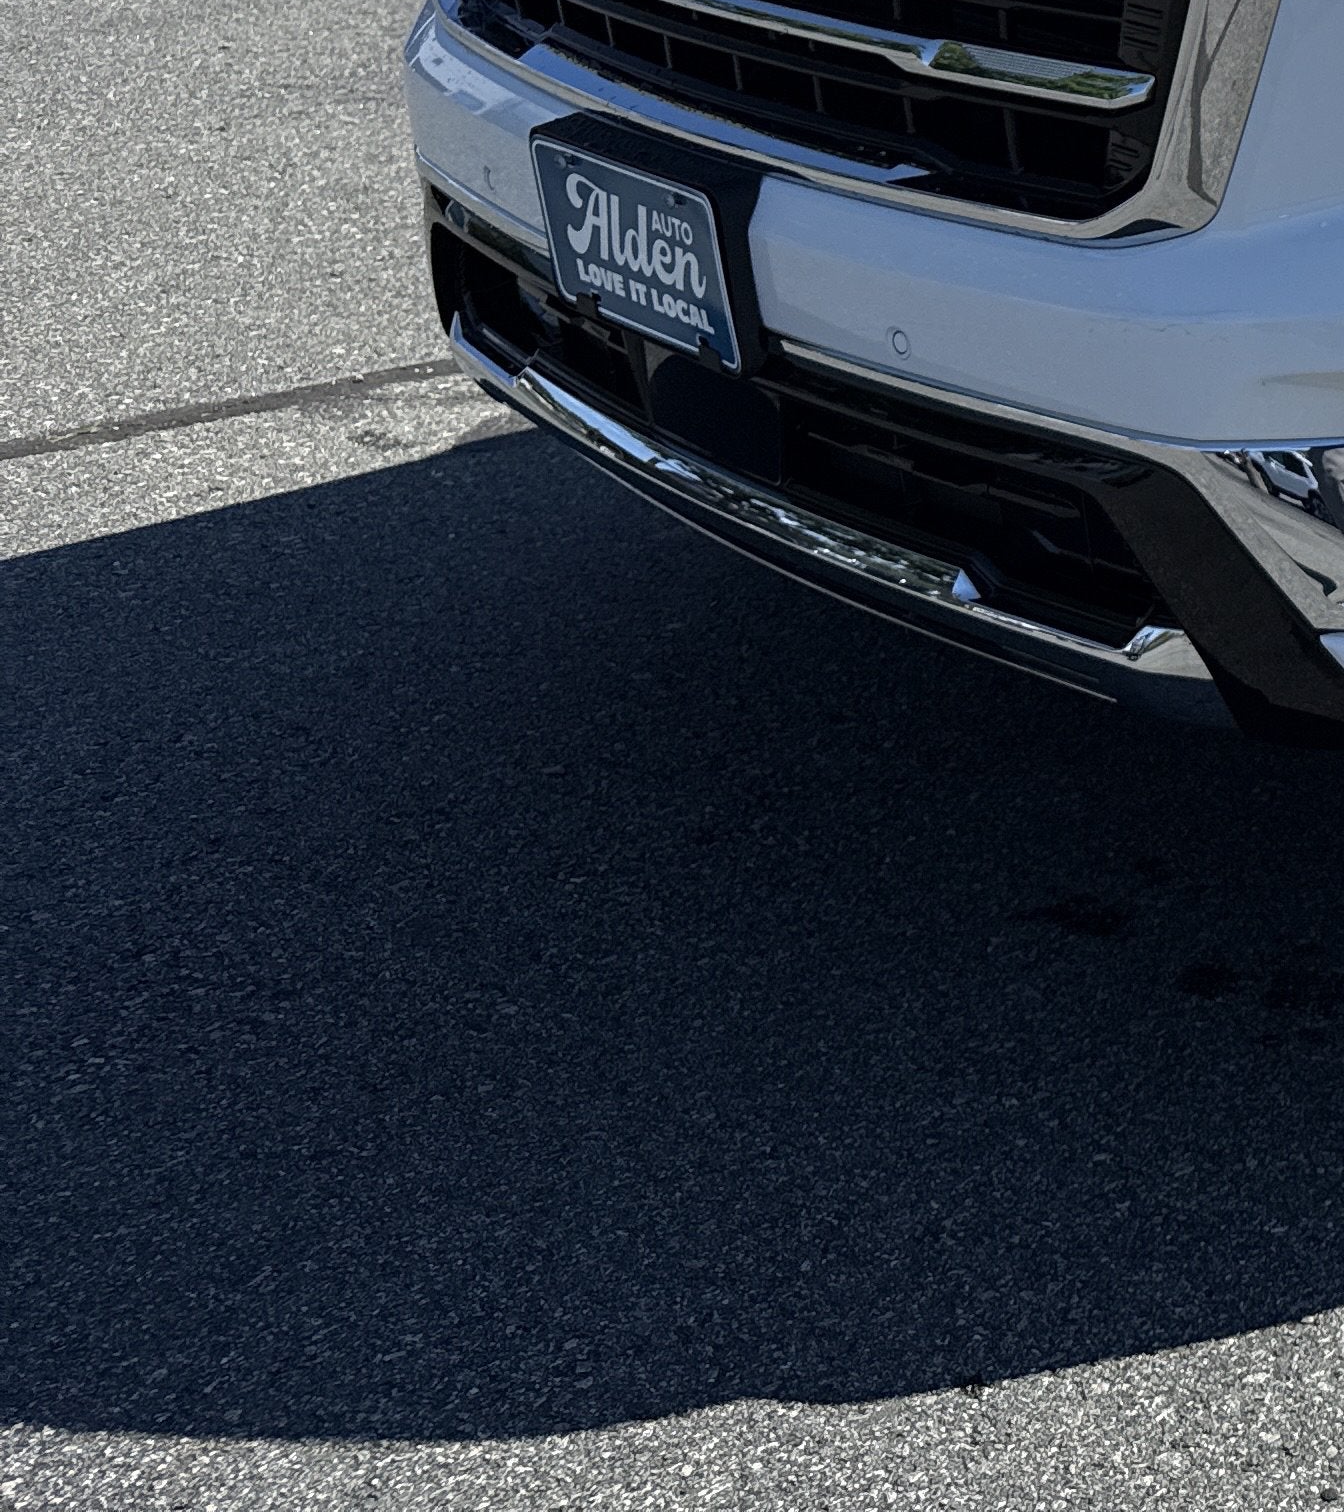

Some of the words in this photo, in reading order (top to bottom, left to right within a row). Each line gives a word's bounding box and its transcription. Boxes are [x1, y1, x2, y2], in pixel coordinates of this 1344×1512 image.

[566, 172, 707, 299] Alden
[651, 209, 693, 246] AUTO
[576, 258, 626, 298] LOVE
[629, 276, 648, 307] IT
[650, 287, 715, 335] LOCAL
